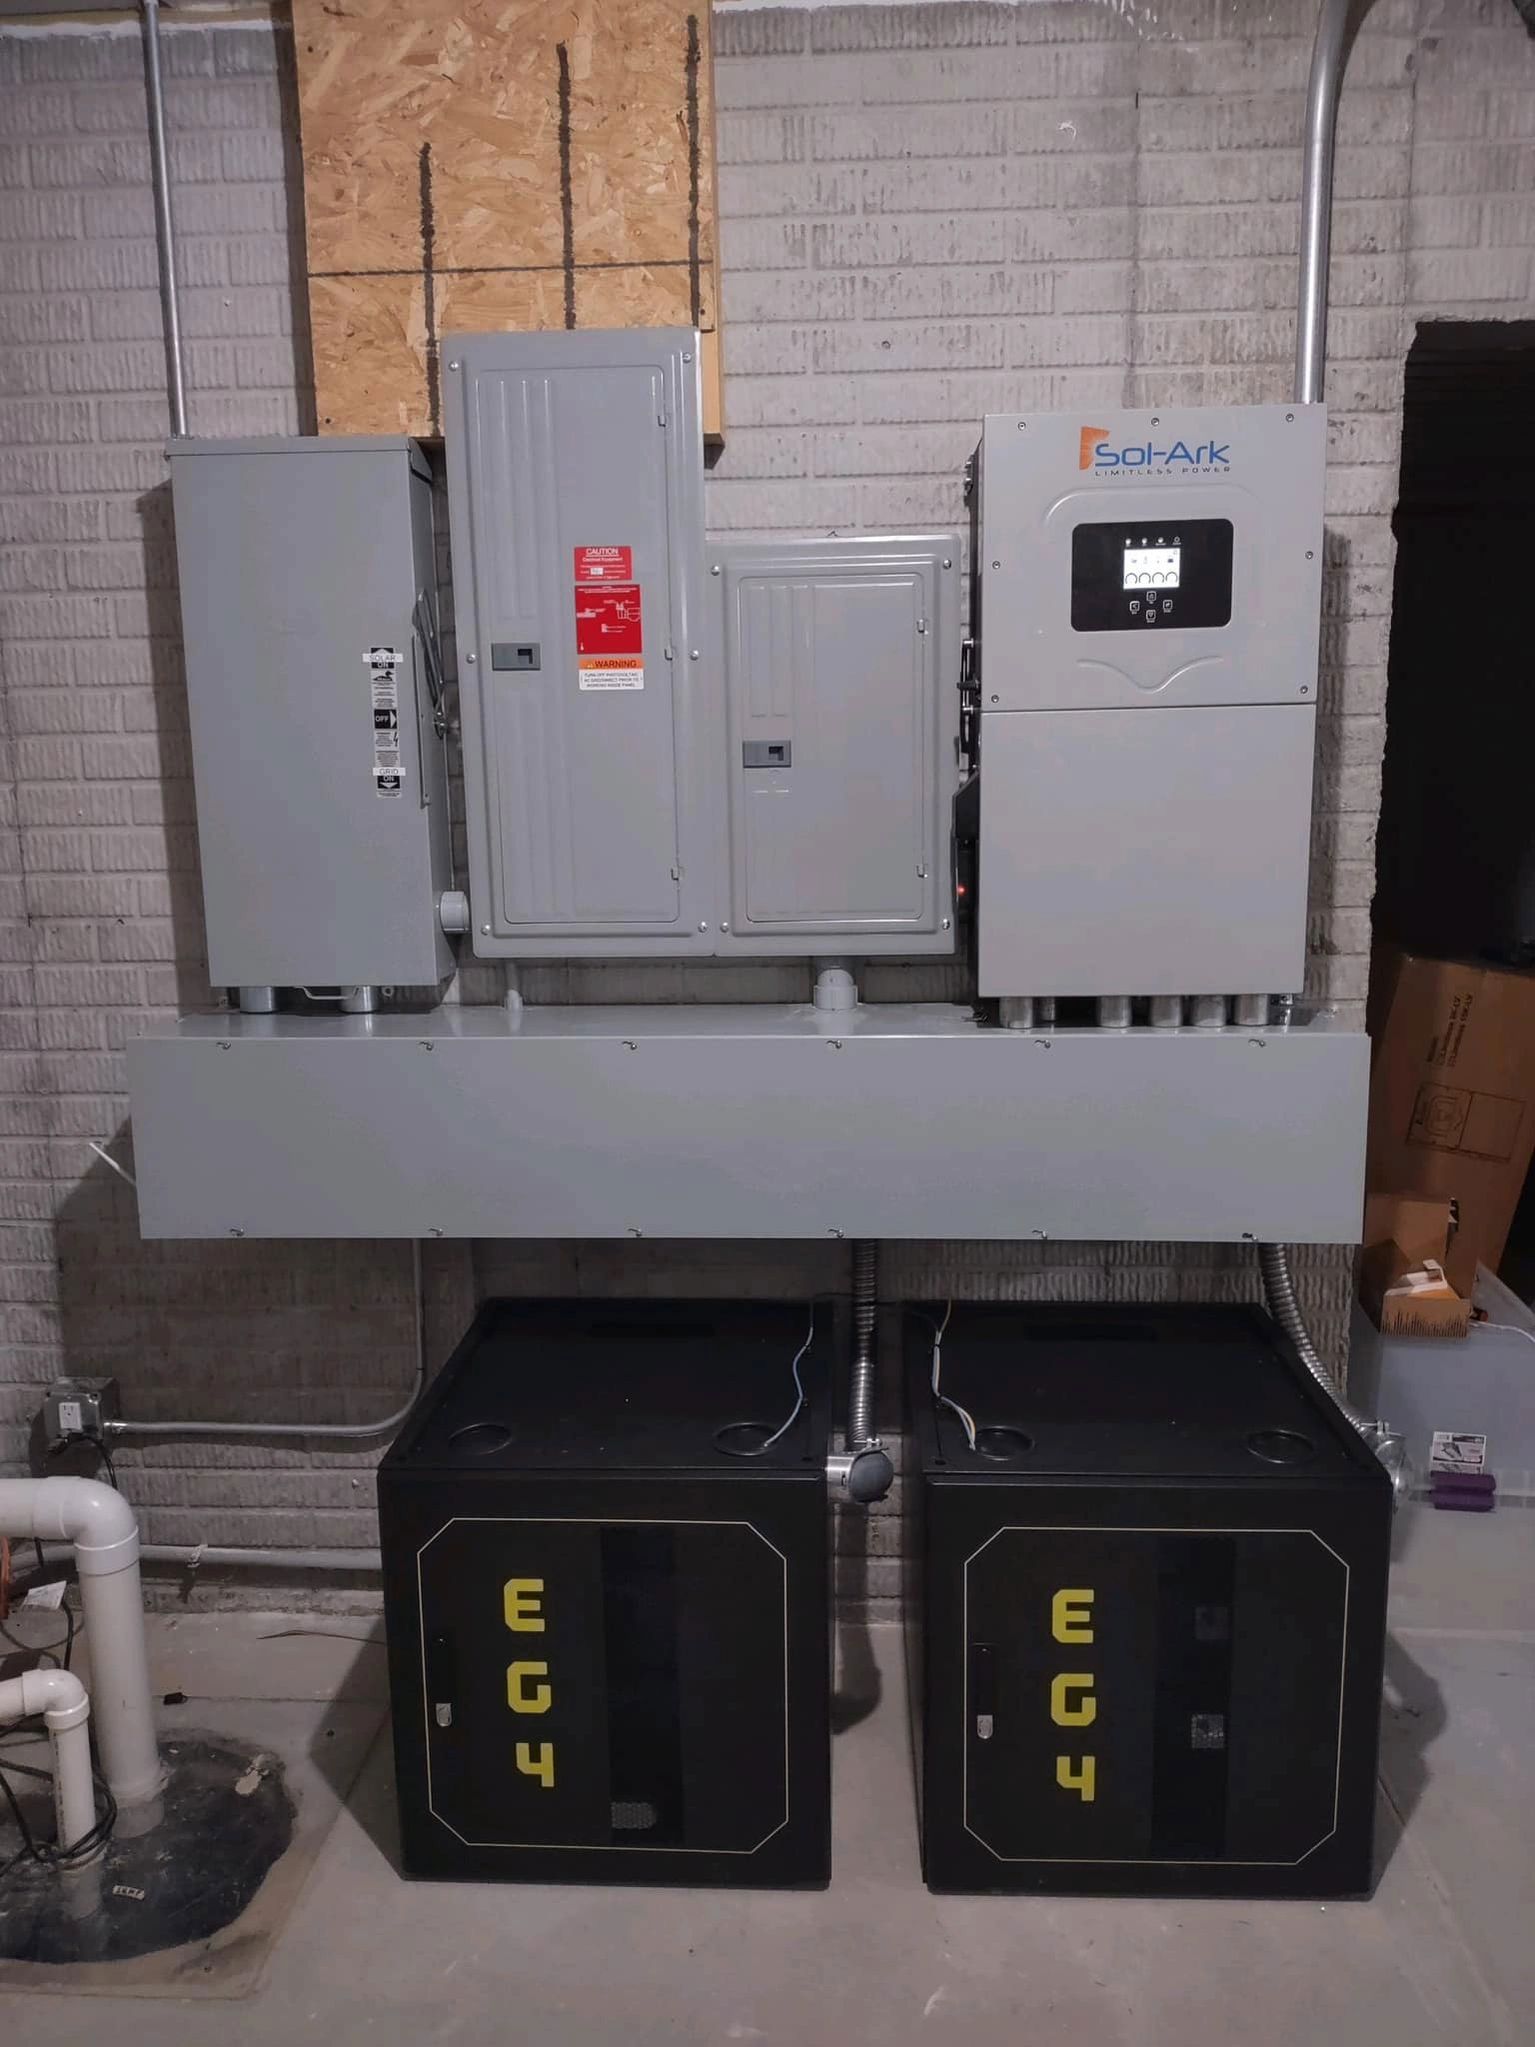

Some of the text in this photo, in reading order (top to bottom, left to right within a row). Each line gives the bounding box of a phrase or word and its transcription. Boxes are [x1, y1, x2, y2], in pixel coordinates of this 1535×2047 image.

[1095, 441, 1230, 467] Sol-Ark
[1095, 469, 1172, 477] LIMITLESS
[595, 660, 637, 668] WARNING
[504, 1578, 554, 1788] EG4
[1051, 1589, 1096, 1802] EG4
